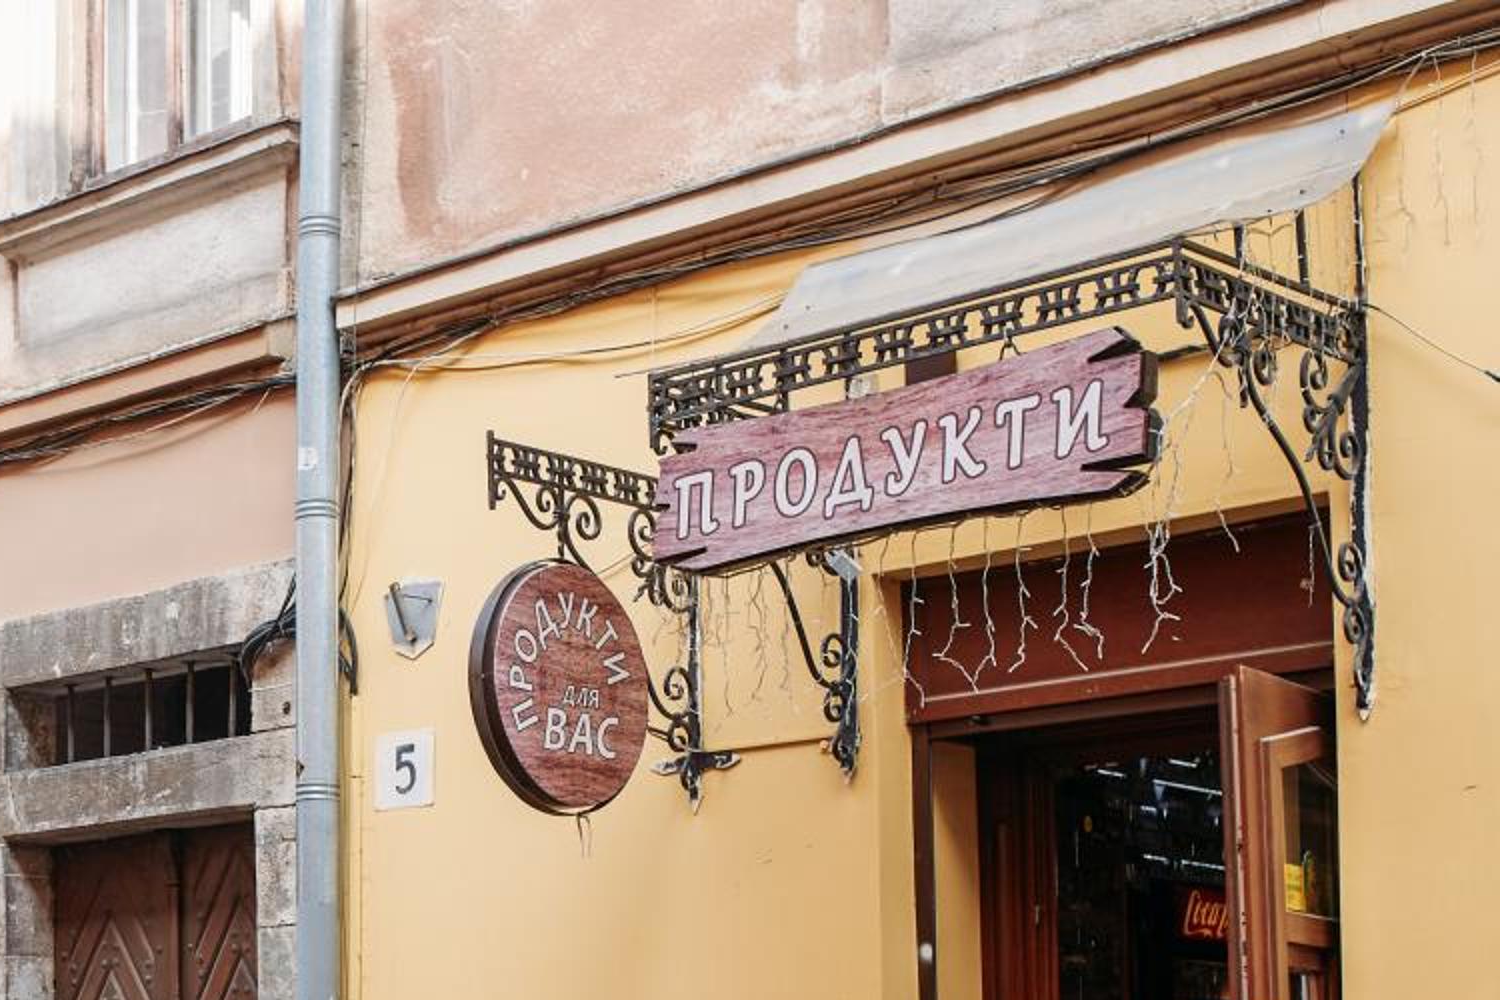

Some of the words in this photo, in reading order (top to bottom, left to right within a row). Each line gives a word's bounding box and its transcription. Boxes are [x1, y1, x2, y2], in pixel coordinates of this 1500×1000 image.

[674, 378, 1111, 541] ПРОДУКТИ
[509, 591, 632, 732] ПРОДУКТИ
[395, 743, 417, 795] 5
[543, 706, 619, 759] ВАС
